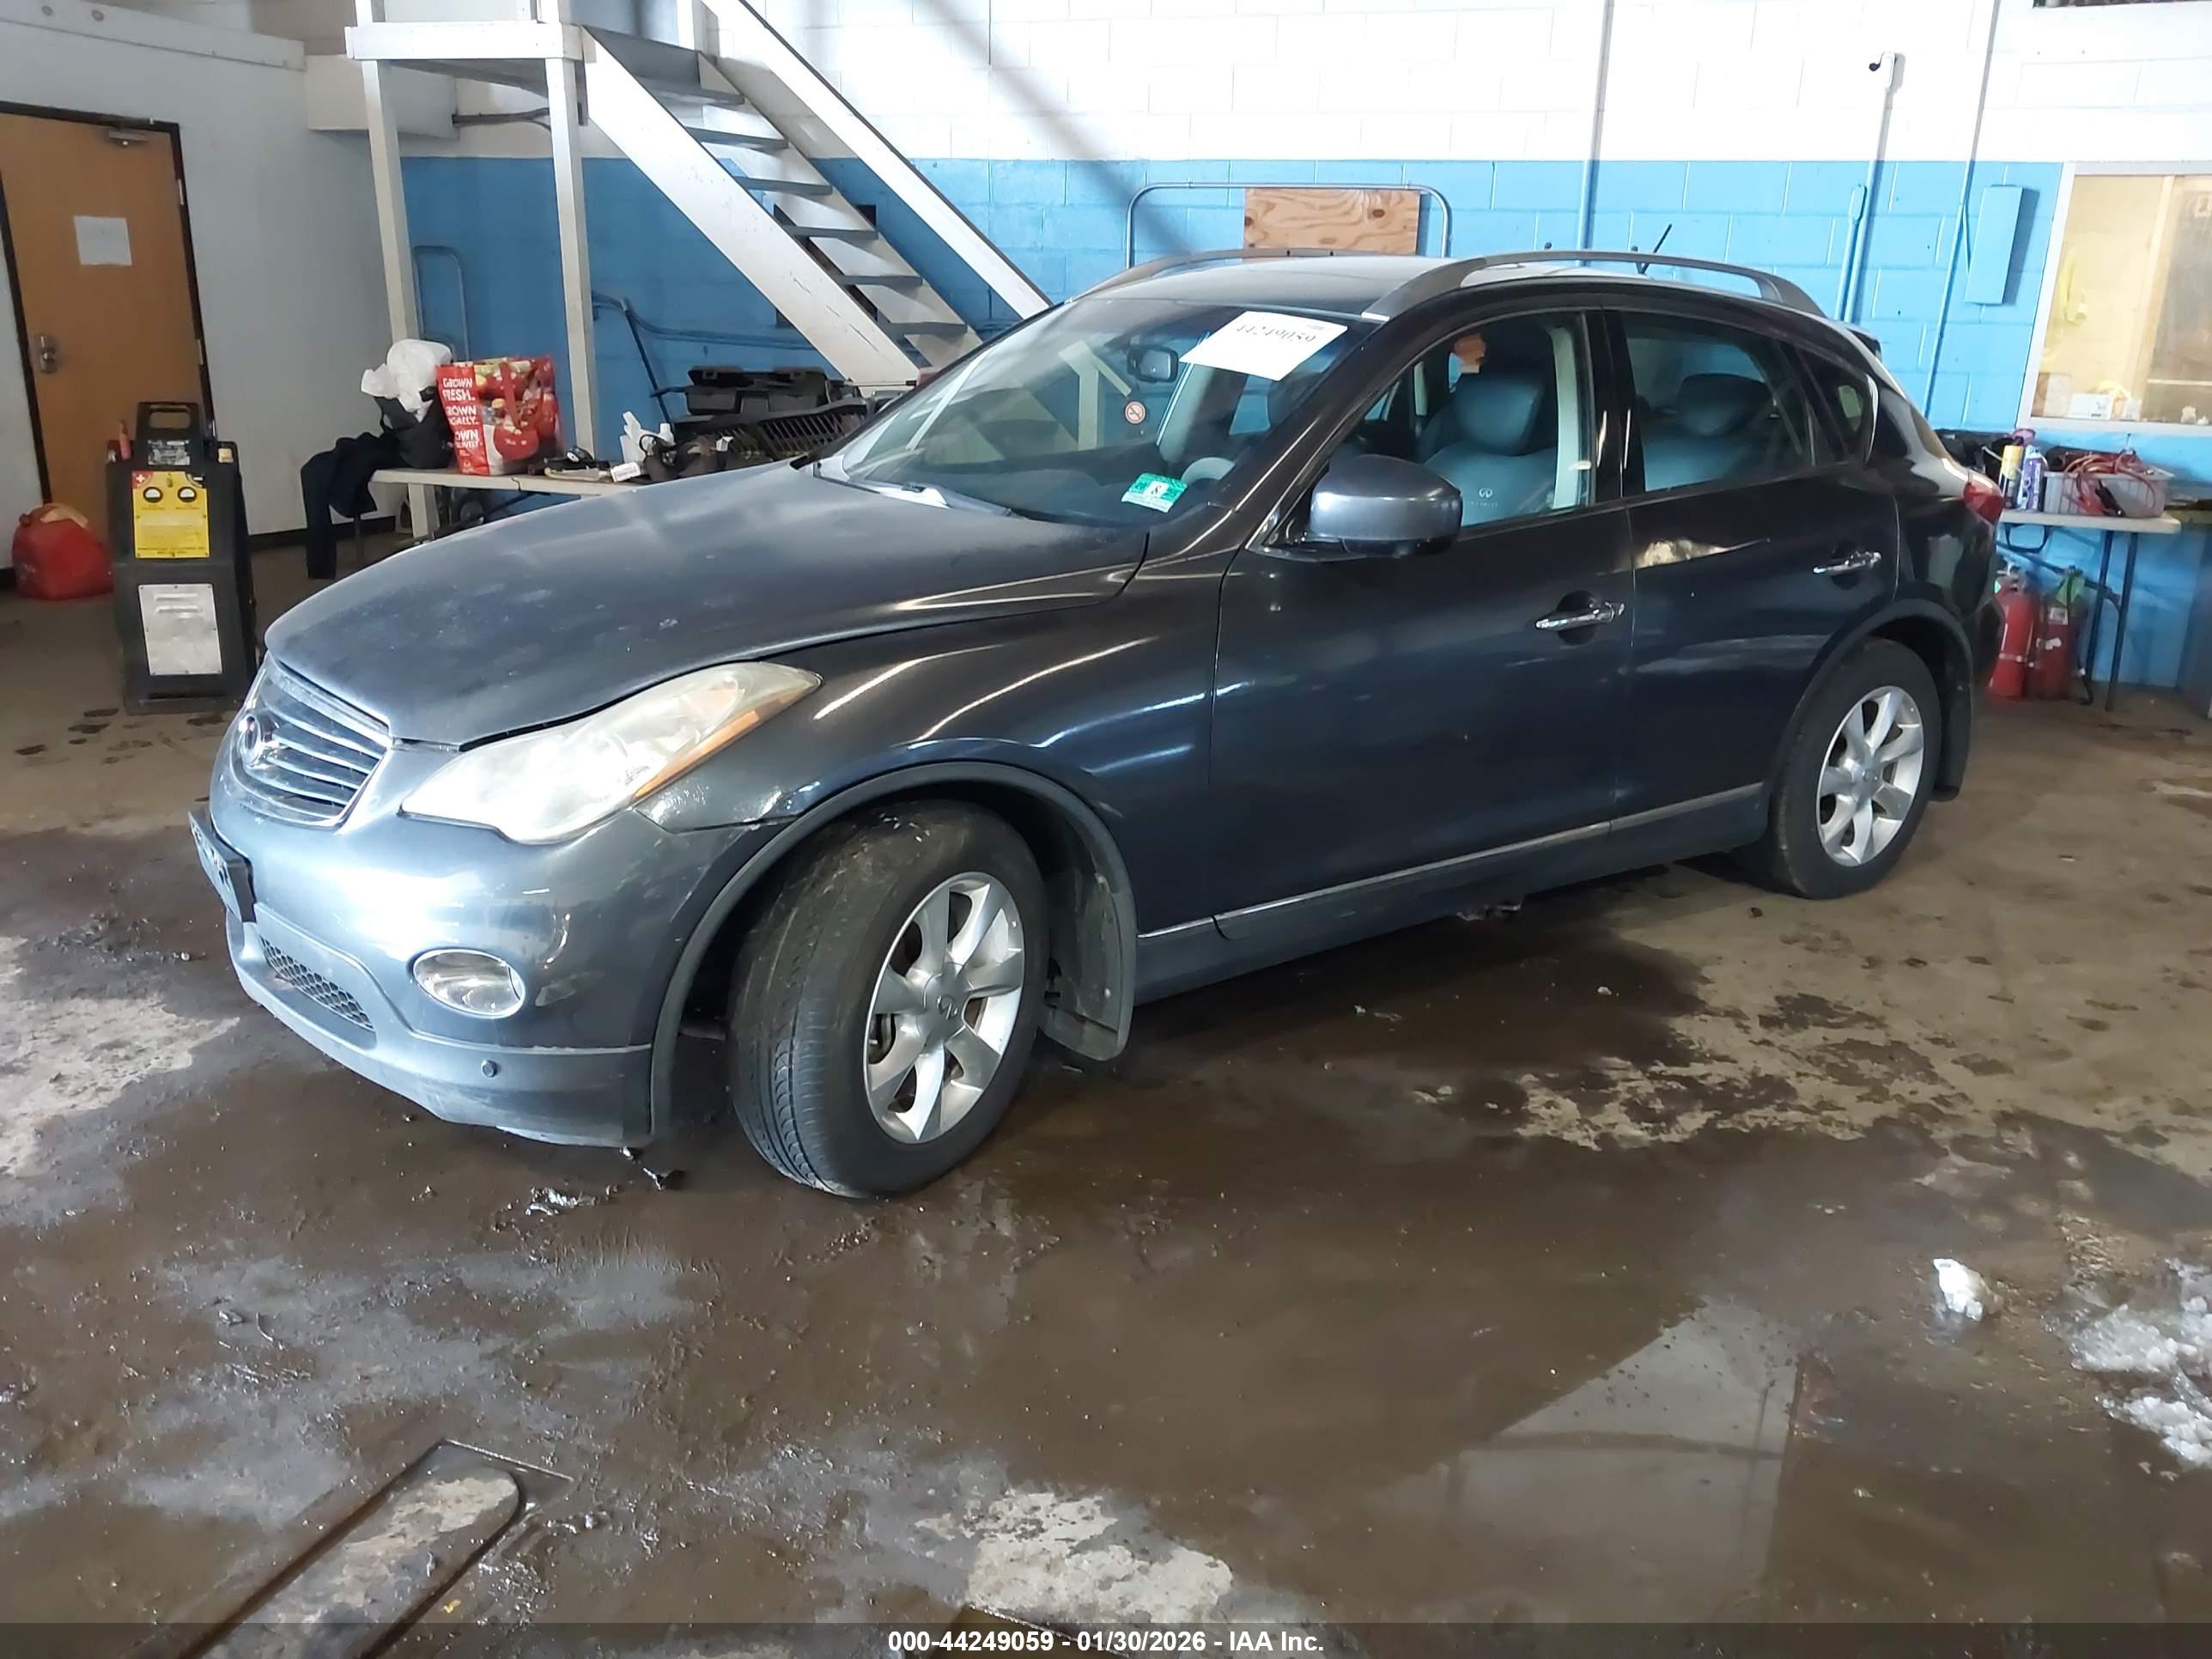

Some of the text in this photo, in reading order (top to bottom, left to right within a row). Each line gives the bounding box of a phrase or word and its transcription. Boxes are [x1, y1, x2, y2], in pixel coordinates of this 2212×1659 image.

[442, 377, 472, 388] GROWN
[445, 404, 477, 416] ROWN
[454, 428, 479, 441] OWN
